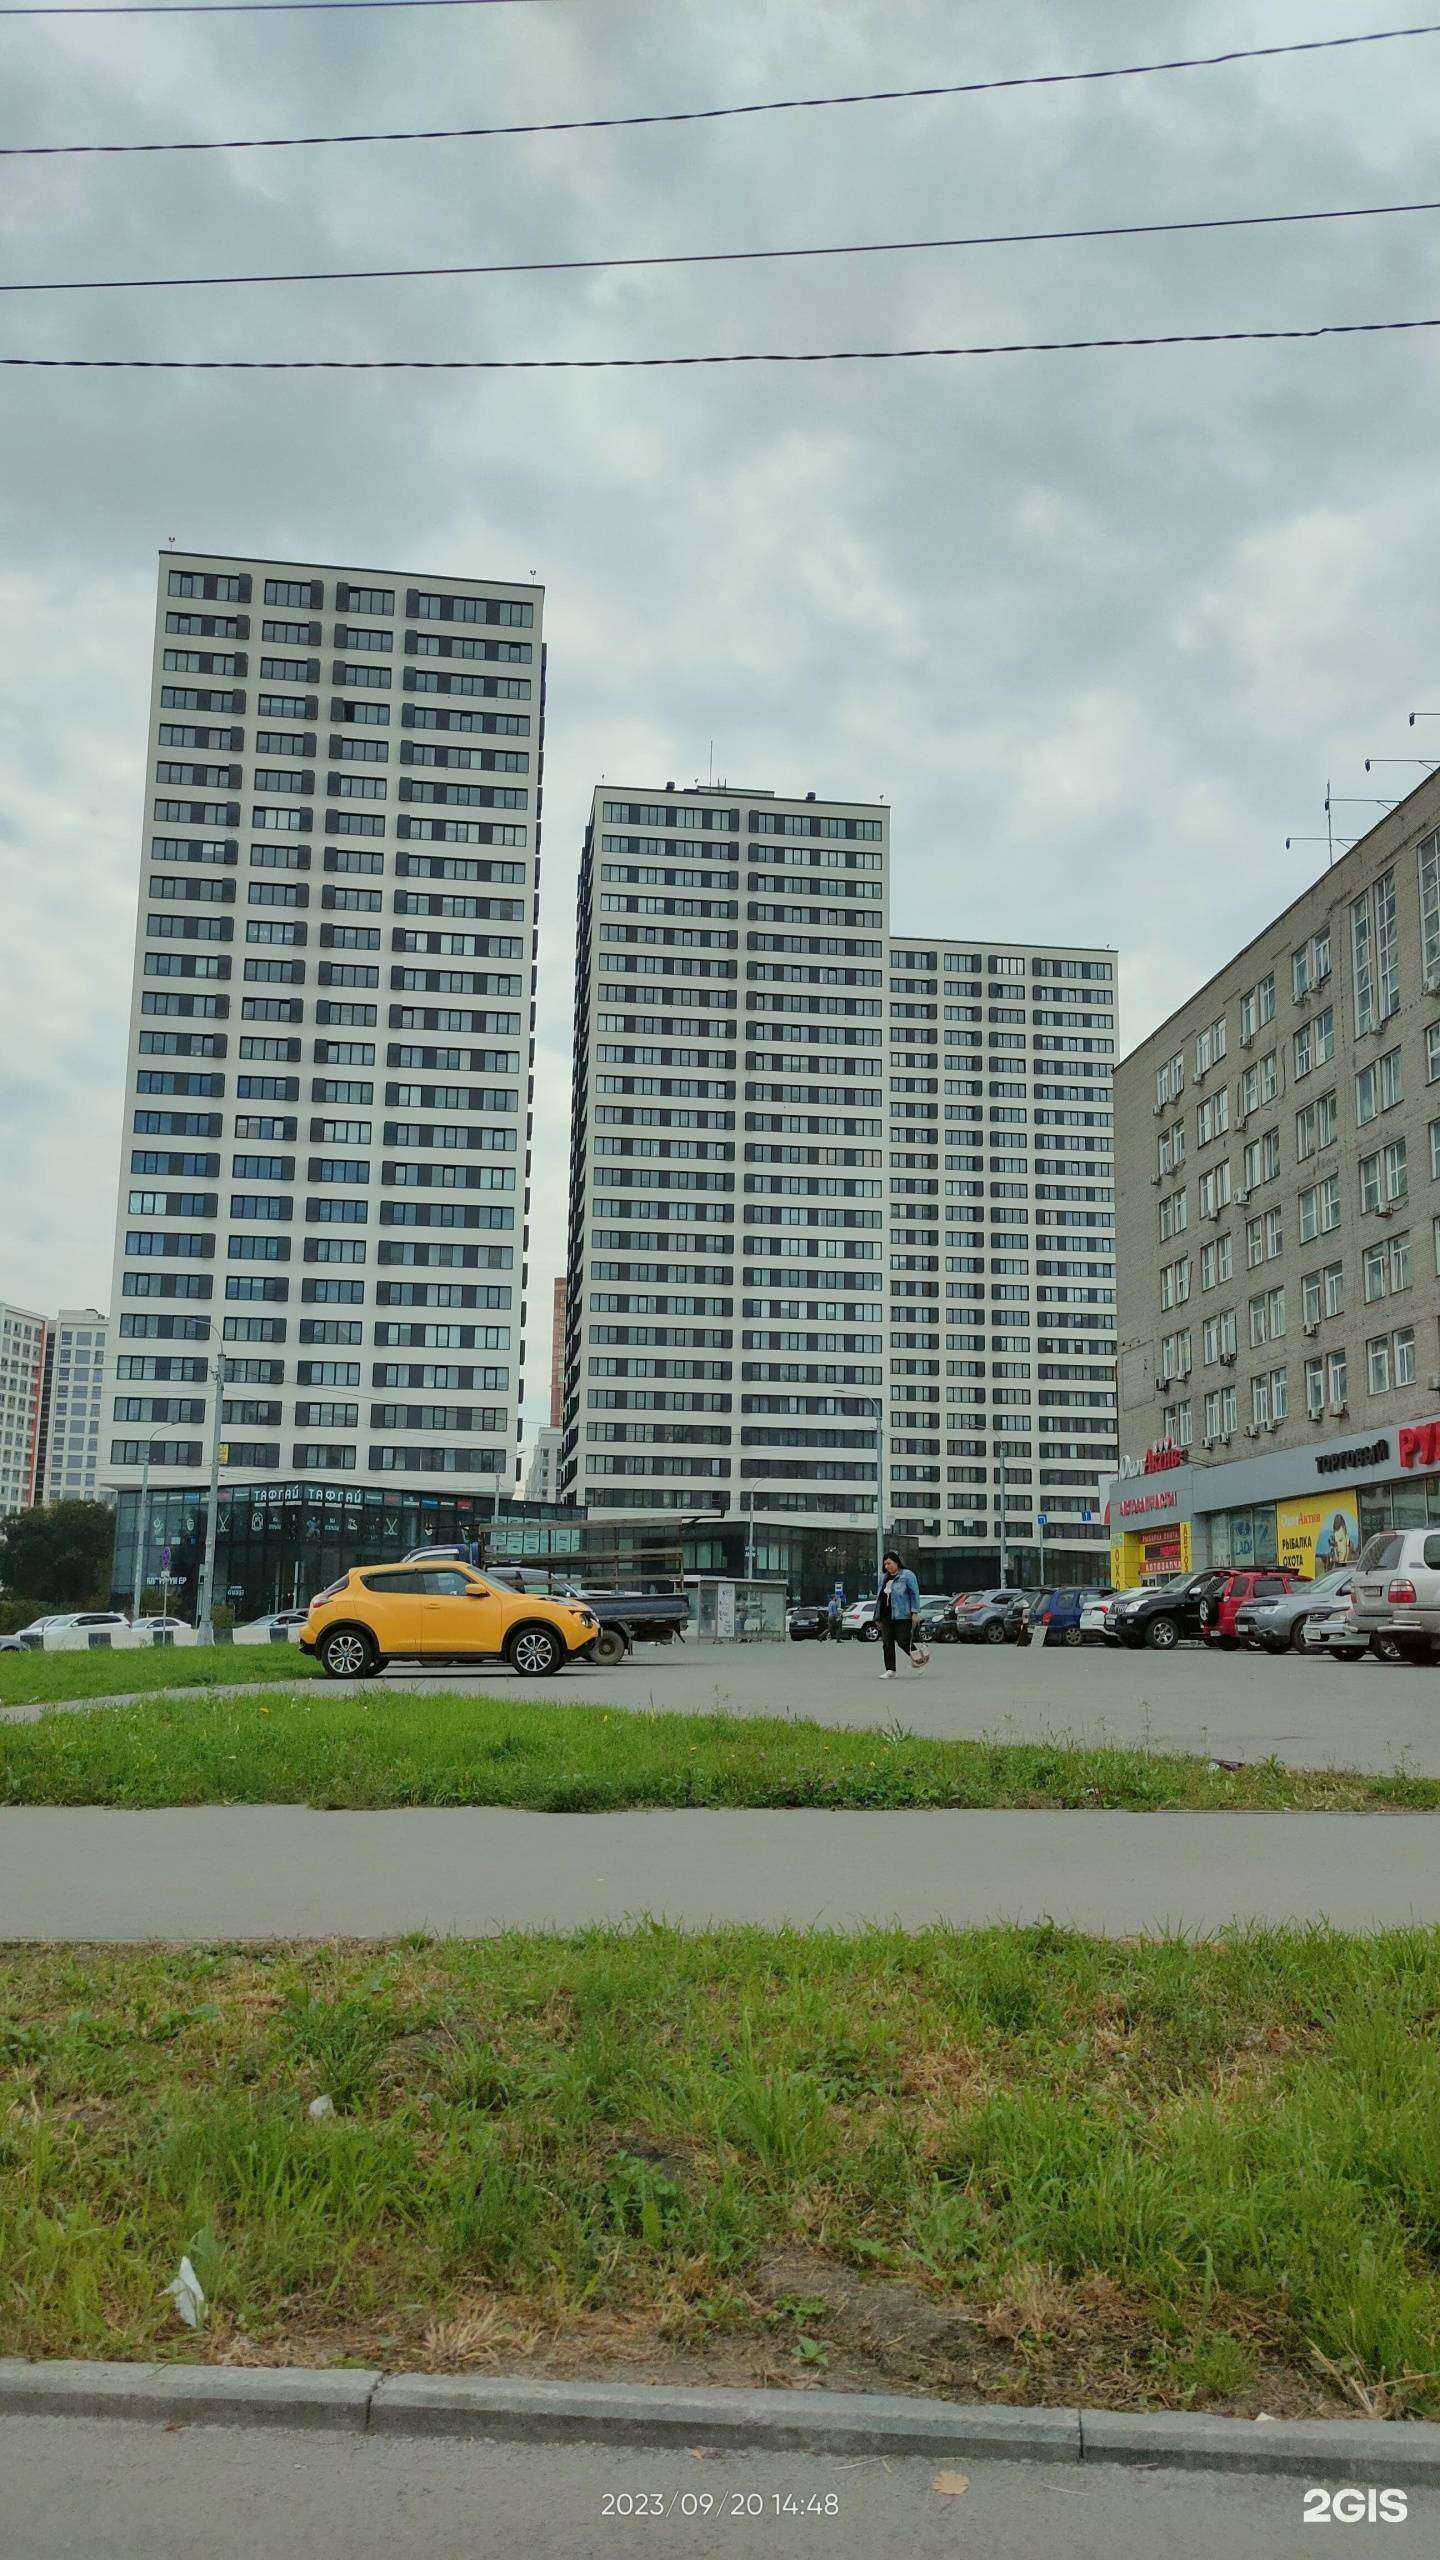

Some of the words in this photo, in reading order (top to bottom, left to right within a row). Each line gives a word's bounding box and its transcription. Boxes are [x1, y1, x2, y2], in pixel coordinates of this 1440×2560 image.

[1399, 1421, 1440, 1467] РУ
[254, 1484, 299, 1501] ТАФГАЙ
[308, 1489, 361, 1503] ТАФГАЙ
[1282, 1535, 1312, 1550] РЫБАЛКА
[1283, 1554, 1304, 1568] ОХОТА
